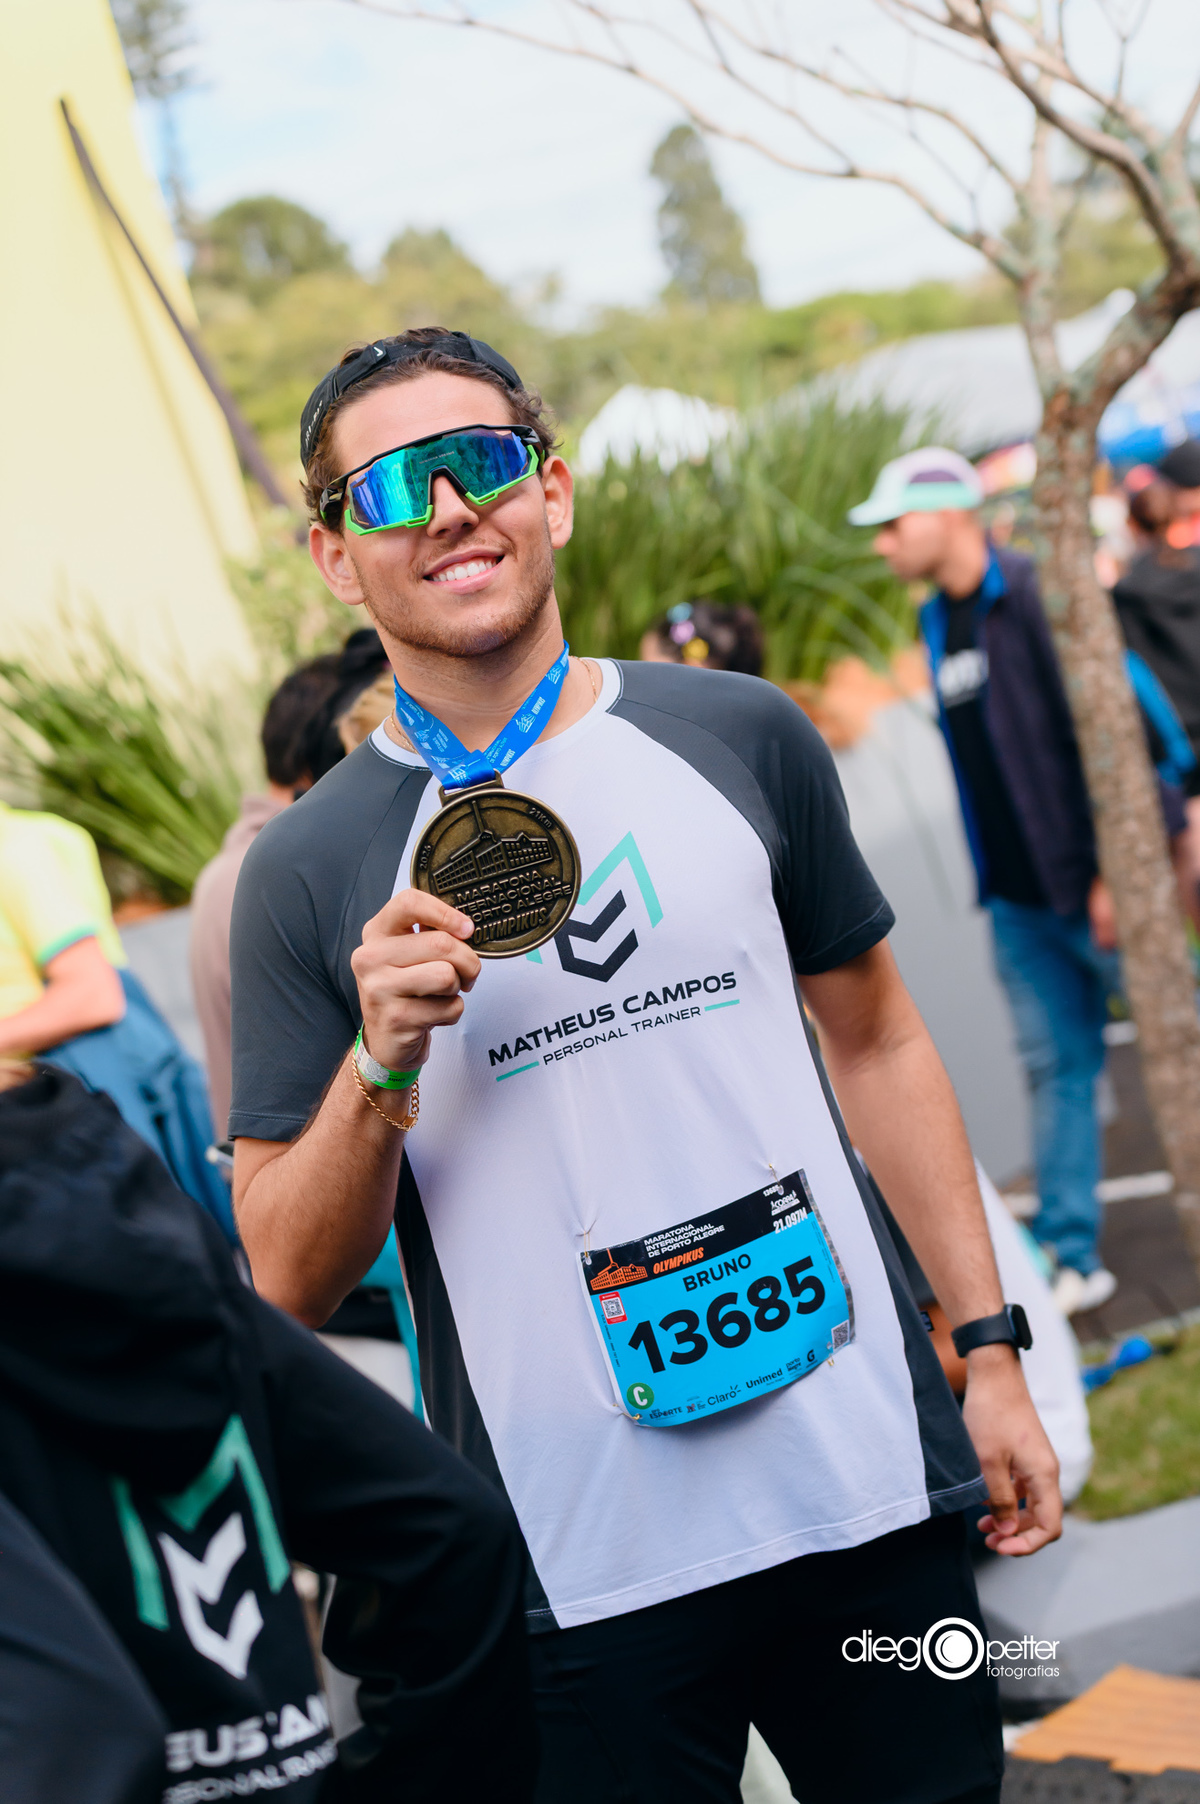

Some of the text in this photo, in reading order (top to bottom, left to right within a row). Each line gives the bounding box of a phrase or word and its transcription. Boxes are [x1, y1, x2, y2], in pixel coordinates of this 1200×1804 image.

[456, 870, 542, 902] MARATONA
[517, 884, 572, 910] ALEGRE
[473, 907, 548, 945] OLYMPIKUS
[488, 971, 737, 1066] MATHEUS CAMPOS
[543, 1006, 702, 1065] PERSONAL TRAINER
[643, 1223, 694, 1246] MARATONA
[645, 1223, 715, 1252] INTERNACIONAL
[648, 1224, 725, 1258] DE PORTO ALEGRE
[653, 1247, 704, 1275] OLYMPIKUS
[683, 1253, 751, 1292] BRUNO
[627, 1255, 826, 1374] 13685
[745, 1368, 783, 1389] Unimed
[634, 1385, 648, 1406] C
[707, 1390, 737, 1406] Claro
